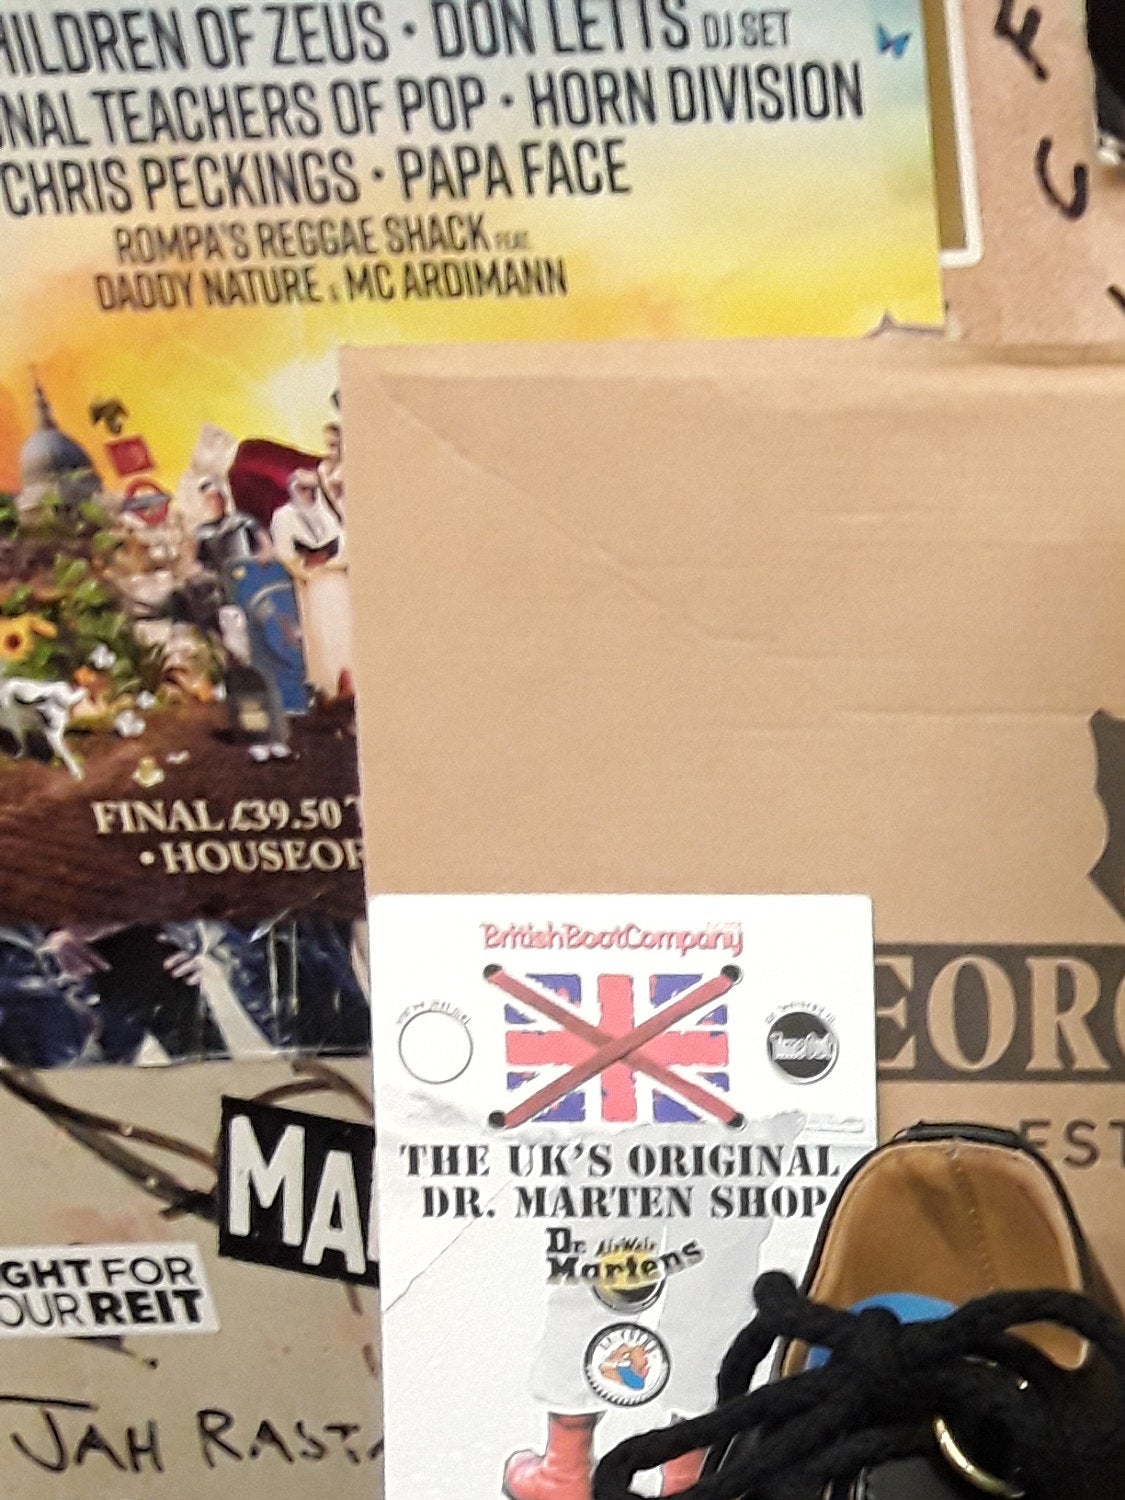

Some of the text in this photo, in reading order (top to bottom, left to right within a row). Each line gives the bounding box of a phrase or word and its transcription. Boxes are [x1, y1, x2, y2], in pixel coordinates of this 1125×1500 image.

[194, 6, 254, 70] OF
[266, 2, 390, 66] ZEUS
[432, 0, 536, 58] DON
[549, 0, 691, 52] LETTS
[702, 19, 736, 49] DJ
[742, 9, 793, 47] SET
[0, 60, 864, 148] NAL TEACHERS OF POP HORN DIVISION
[1, 136, 633, 215] CHRIS PECKINGS PAPA FACE
[114, 222, 249, 263] ROMPA'S
[256, 216, 378, 259] REGGAE
[383, 212, 492, 253] SHACK
[95, 271, 193, 311] DADDY
[201, 265, 323, 306] NATURE
[344, 261, 395, 300] MC
[402, 256, 569, 300] ARDIMANN
[91, 798, 342, 835] FINAL £39.50
[400, 1144, 840, 1177] THE UK'S ORIGINAL
[228, 1114, 380, 1276] MA
[421, 1185, 828, 1219] DR. MARTEN SHOP
[101, 1256, 194, 1287] FOR
[546, 1240, 704, 1285] Martens
[88, 1288, 203, 1326] REIT
[9, 1402, 165, 1474] JAH
